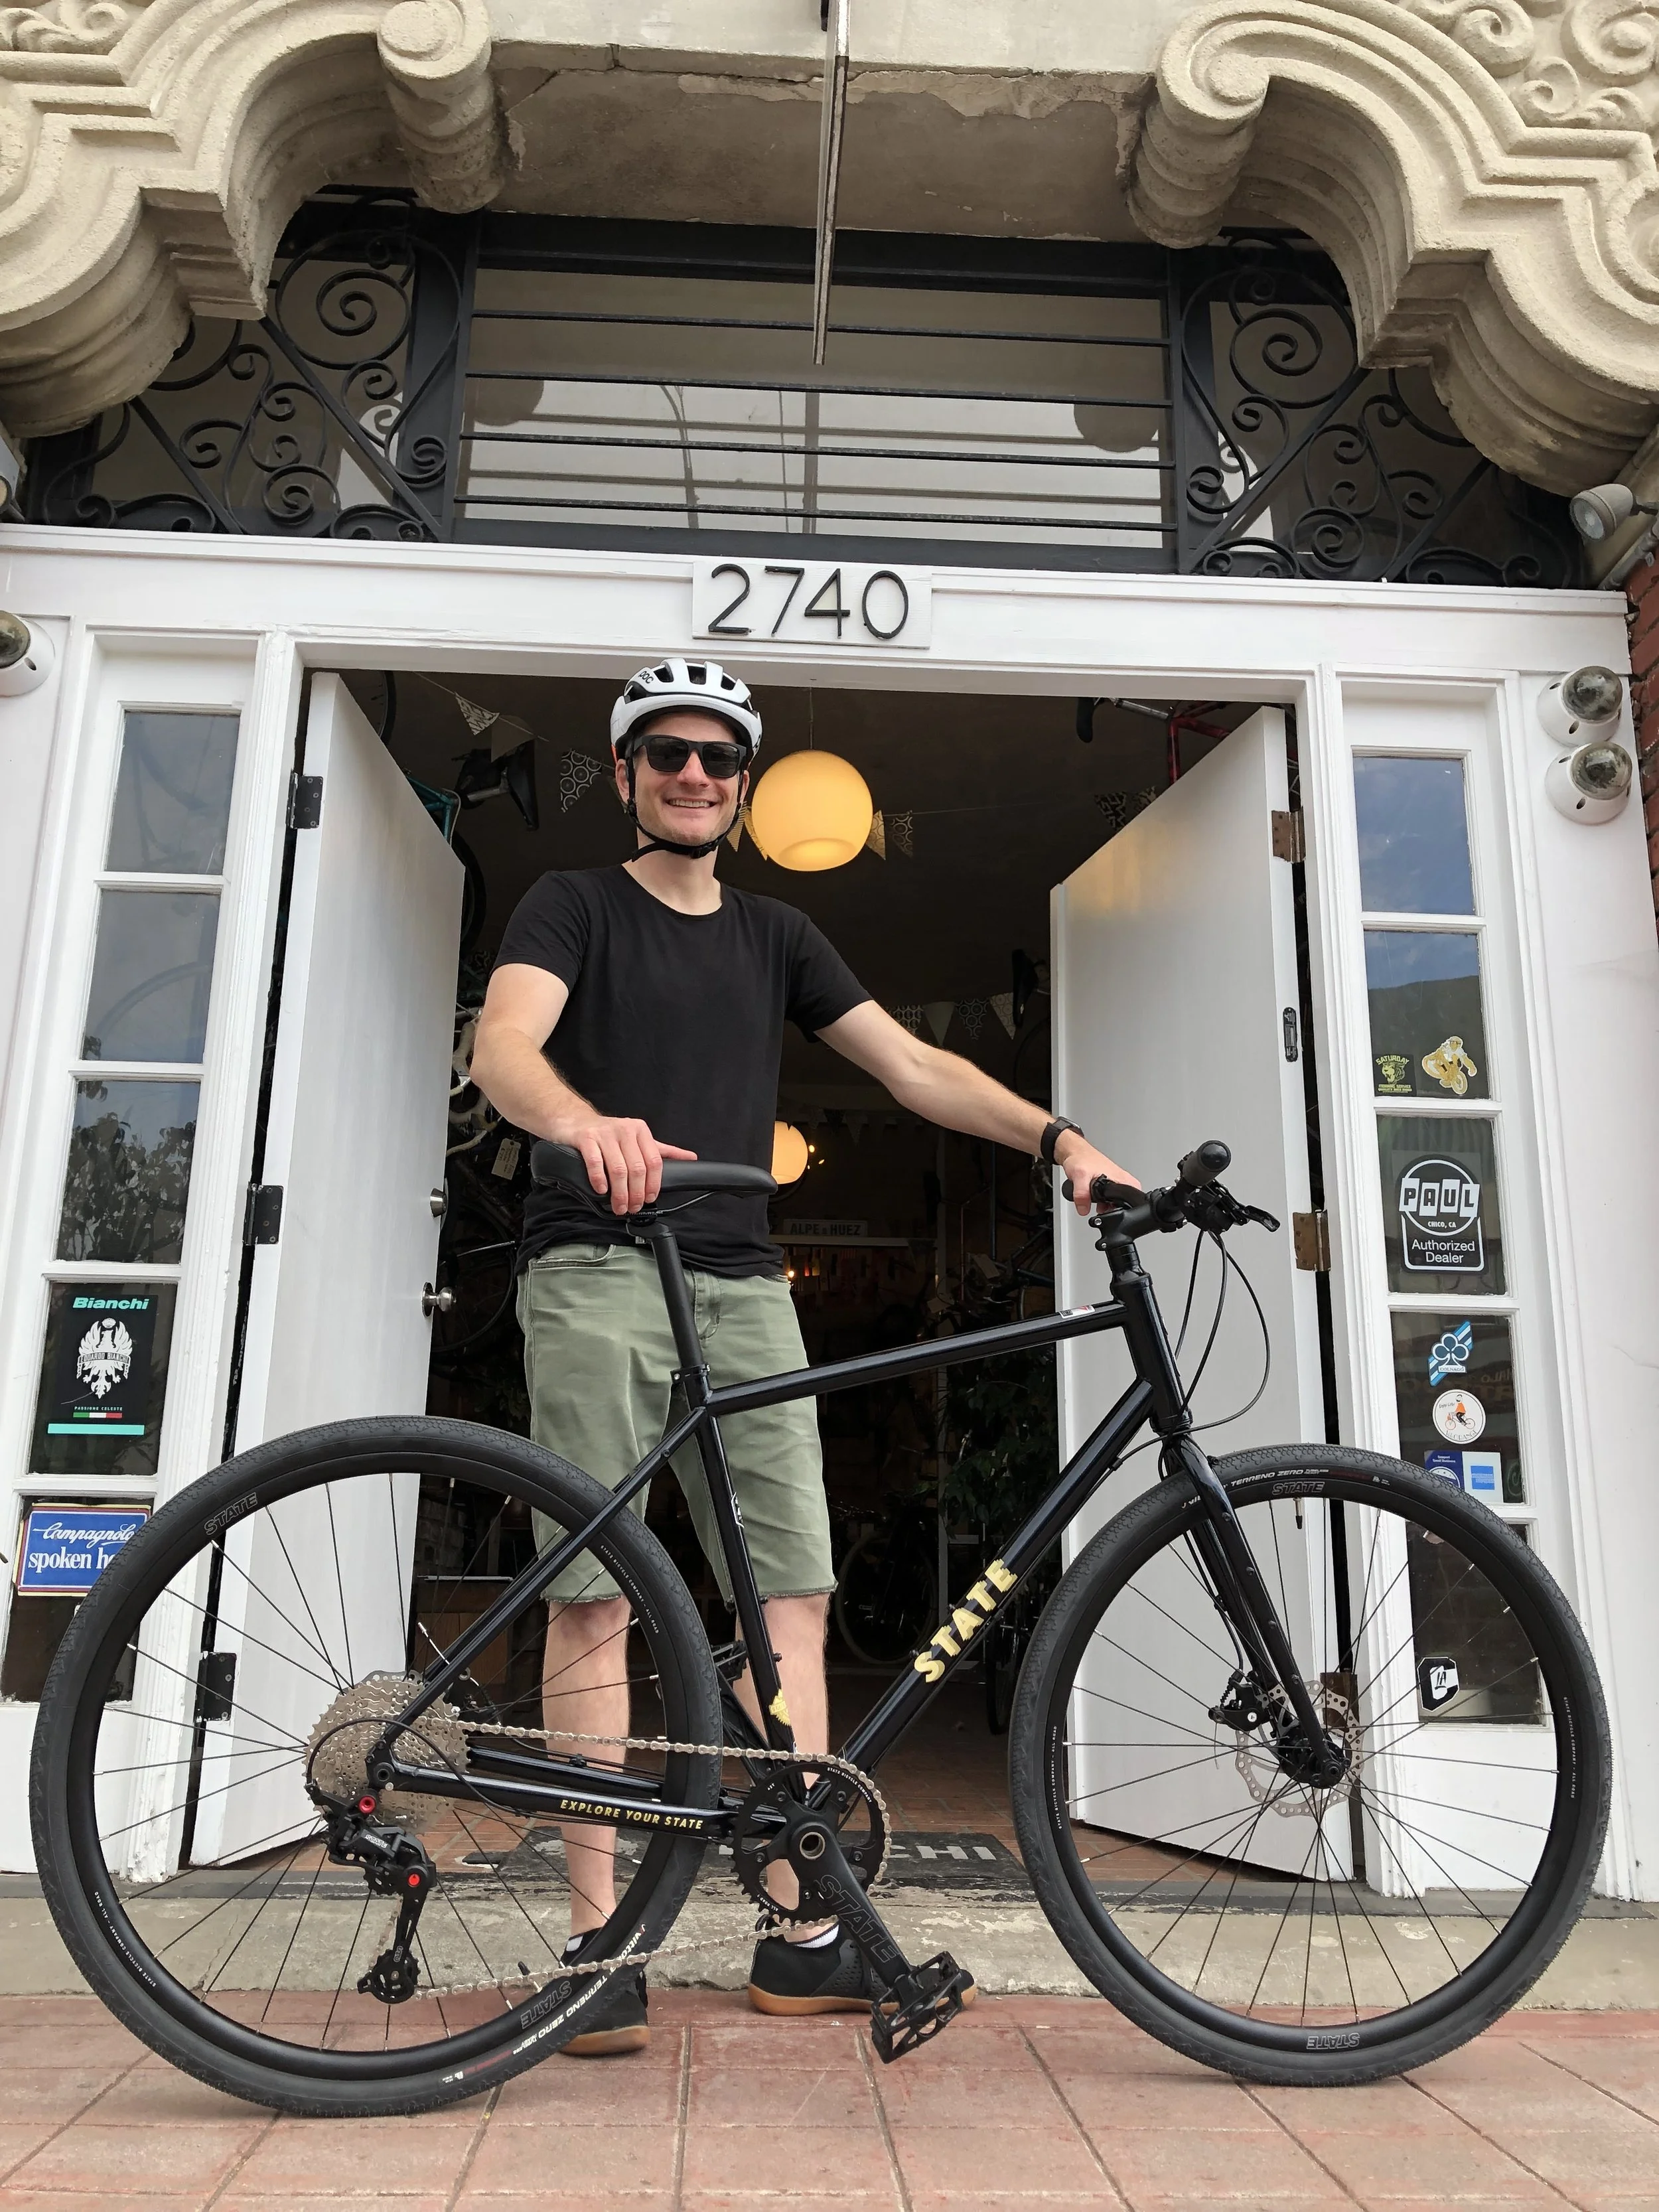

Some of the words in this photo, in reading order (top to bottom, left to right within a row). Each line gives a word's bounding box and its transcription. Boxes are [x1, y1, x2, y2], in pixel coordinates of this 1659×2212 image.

[708, 563, 908, 639] 2740
[1375, 1055, 1409, 1065] SATURDAY
[1402, 1185, 1477, 1210] PAUL
[790, 1223, 820, 1234] ALPE
[830, 1224, 861, 1236] HUEZ
[1411, 1238, 1475, 1252] Authorized
[1425, 1252, 1464, 1264] Dealer
[72, 1297, 149, 1310] Bianchi
[80, 1353, 106, 1363] EDOARDO
[107, 1353, 129, 1363] BIANCHI
[1230, 1472, 1275, 1487] TERRENO
[1272, 1481, 1325, 1495] STATE
[204, 1492, 258, 1536] STATE
[33, 1522, 137, 1549] Campagnolo
[28, 1546, 92, 1573] spoken
[914, 1559, 1018, 1682] STATE
[827, 1767, 840, 1775] STATE
[841, 1771, 857, 1786] BICYCLE
[857, 1784, 872, 1803] COMPANY
[560, 1799, 621, 1818] EXPLORE
[626, 1810, 660, 1824] YOUR
[664, 1816, 703, 1830] STATE
[365, 1834, 387, 1848] STATE
[94, 1891, 103, 1907] ROAD
[814, 1875, 897, 1962] STATE
[109, 1925, 126, 1951] COMPANY
[125, 1951, 143, 1972] BICYCLE
[142, 1972, 157, 1987] STATE
[520, 1980, 572, 2029] STATE
[566, 1975, 608, 2018] TERRENO
[538, 2014, 564, 2039] ZERO
[1307, 2033, 1360, 2049] STATE
